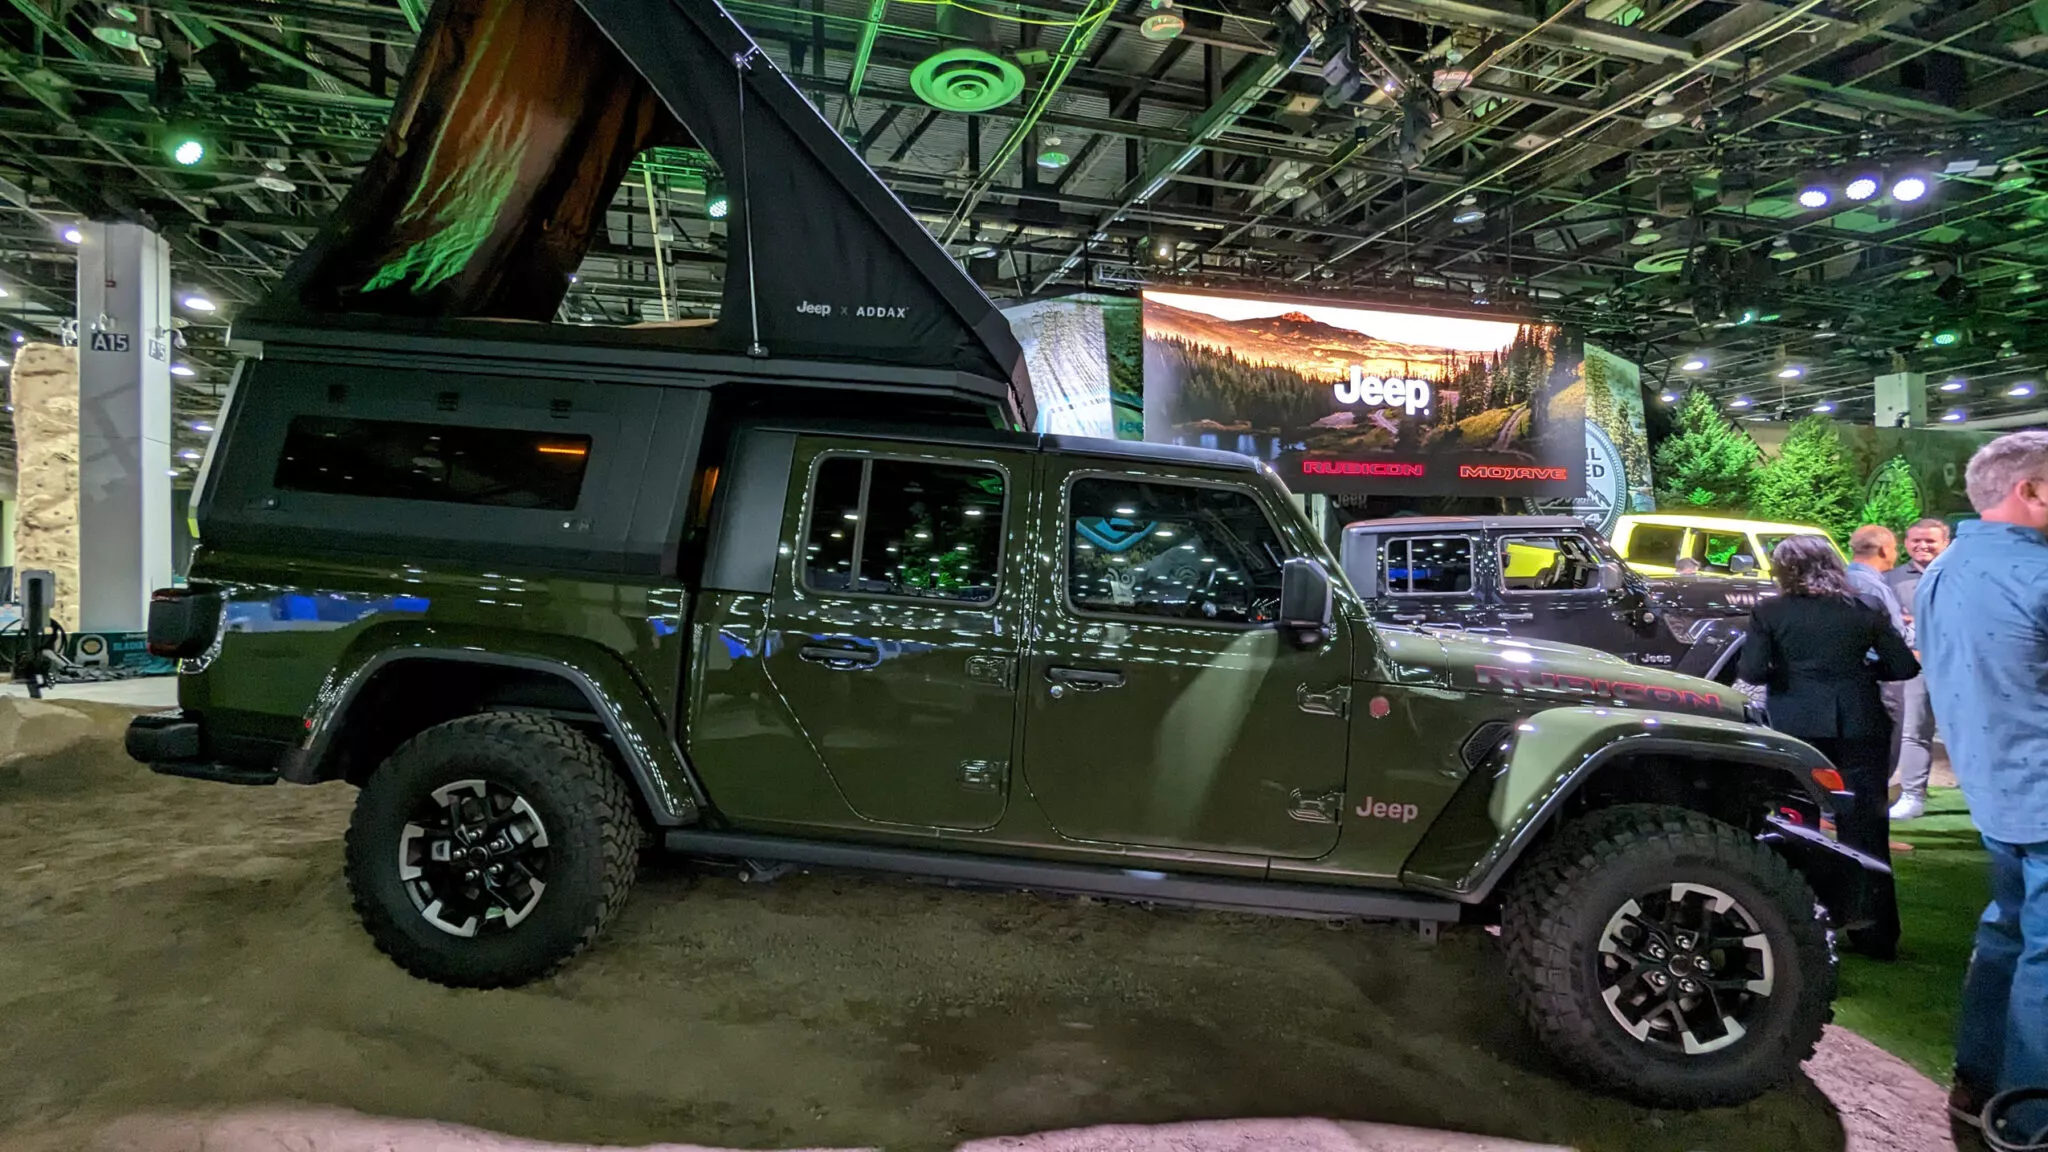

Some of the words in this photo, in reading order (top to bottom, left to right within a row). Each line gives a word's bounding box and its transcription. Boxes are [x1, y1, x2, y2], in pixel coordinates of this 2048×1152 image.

[796, 300, 832, 317] Jeep
[856, 306, 906, 318] ADDAX
[94, 333, 128, 351] A15
[1333, 364, 1430, 416] Jeep
[1302, 461, 1424, 477] RUBICON
[1459, 464, 1568, 480] MOJAVE
[1641, 652, 1672, 664] Jeep
[1474, 665, 1724, 711] RUBICON
[1356, 796, 1419, 823] Jeep
